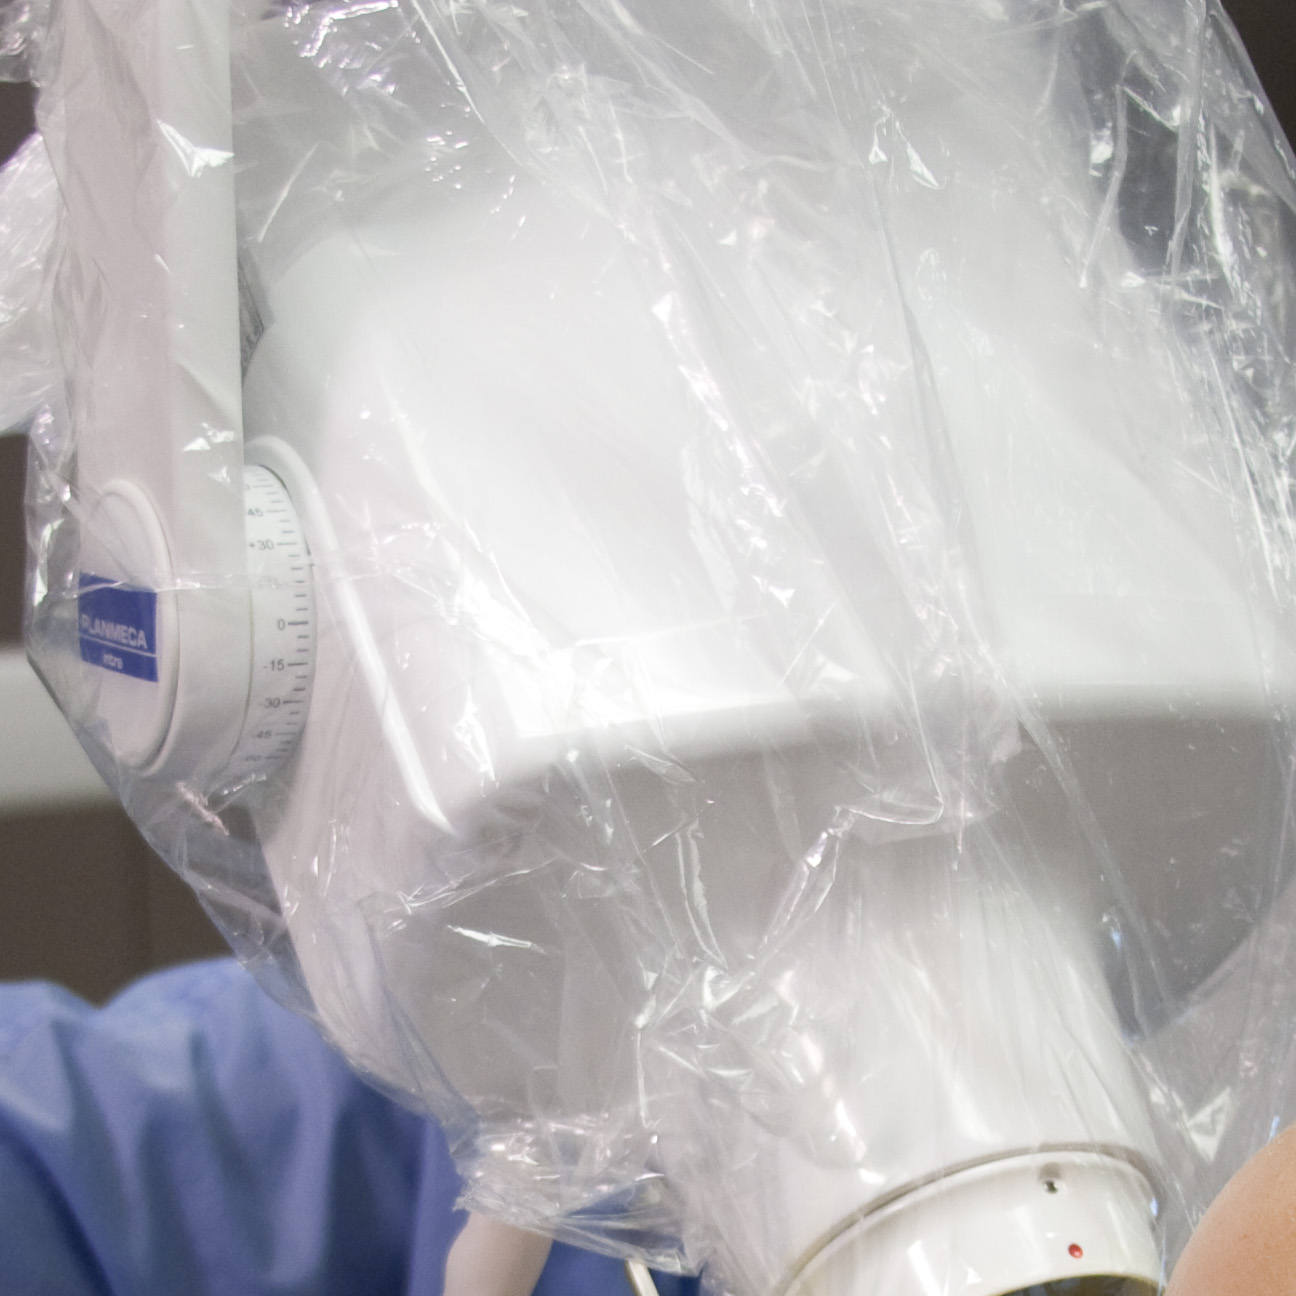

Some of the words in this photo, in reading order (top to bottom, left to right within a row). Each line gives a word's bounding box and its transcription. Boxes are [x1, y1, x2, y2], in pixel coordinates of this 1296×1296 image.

[277, 618, 286, 631] 0
[80, 613, 148, 650] PLANMECA
[262, 659, 285, 671] -15
